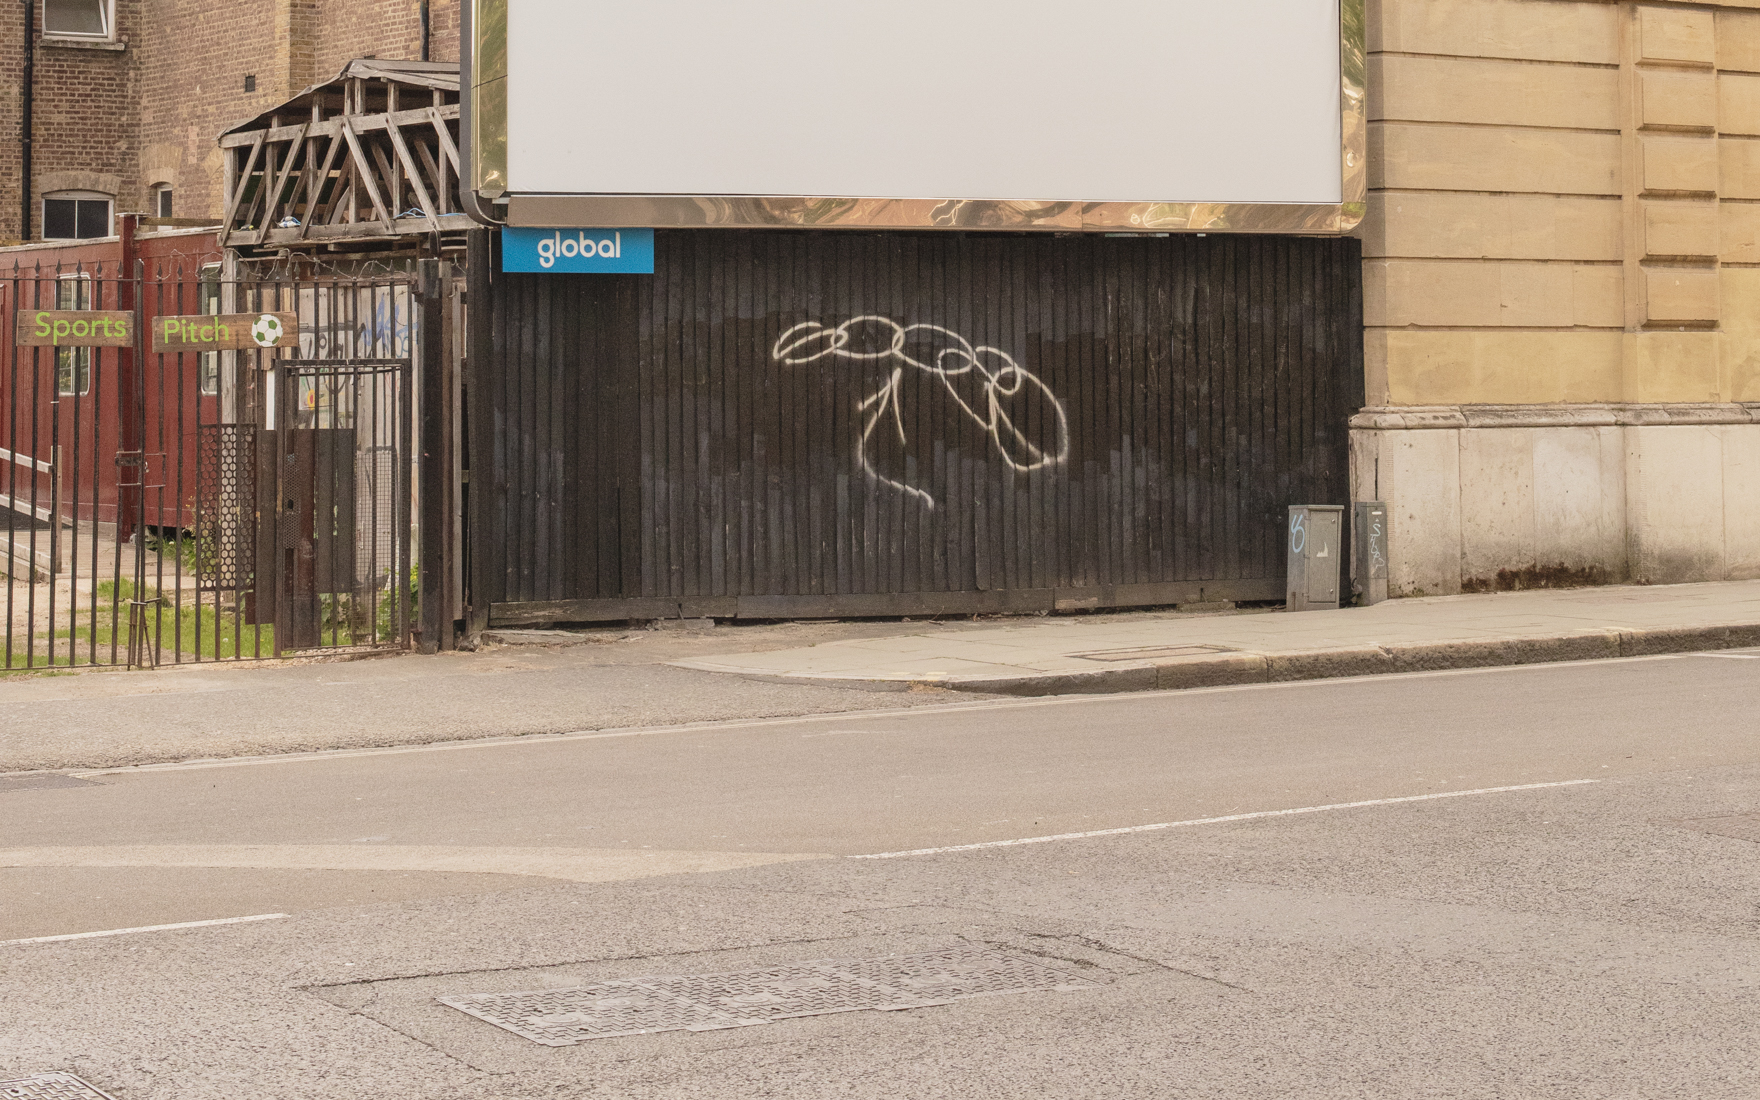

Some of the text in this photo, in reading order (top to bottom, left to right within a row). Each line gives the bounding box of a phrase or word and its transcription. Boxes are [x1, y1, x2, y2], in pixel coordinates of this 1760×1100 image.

[537, 230, 621, 269] global
[34, 311, 127, 346] Sports
[163, 316, 230, 344] Pitch
